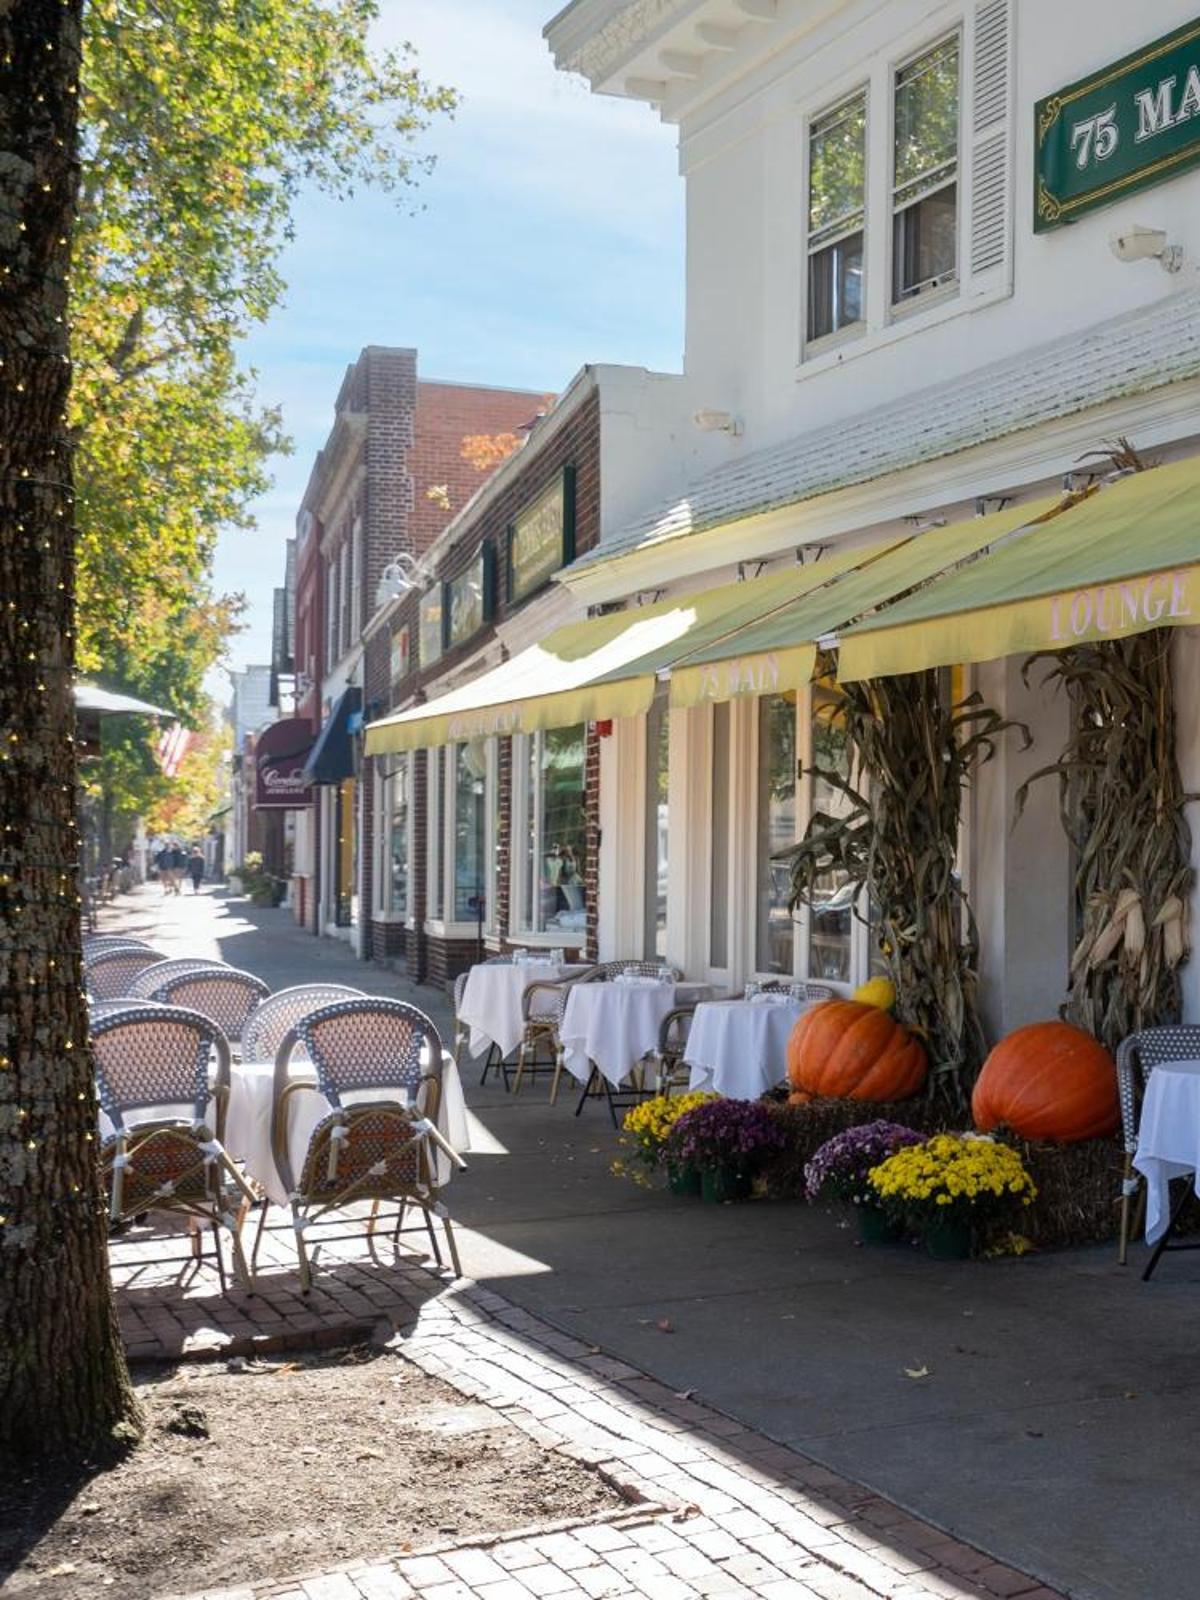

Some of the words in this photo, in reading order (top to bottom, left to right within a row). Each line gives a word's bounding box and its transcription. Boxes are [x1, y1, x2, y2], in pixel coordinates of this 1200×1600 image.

[1070, 102, 1120, 171] 75
[1052, 569, 1192, 641] LOUNGE
[728, 651, 780, 696] MAIN
